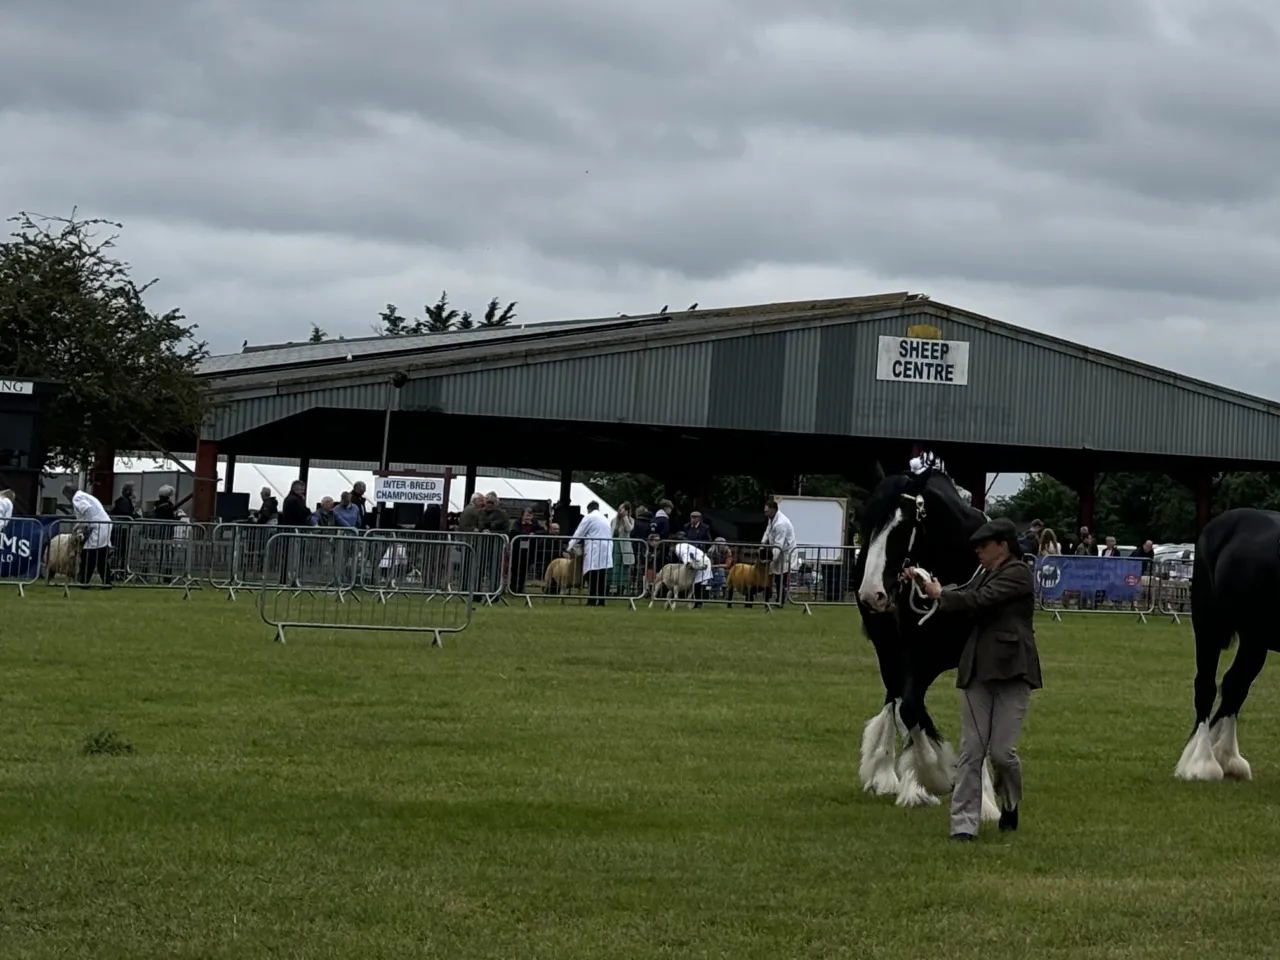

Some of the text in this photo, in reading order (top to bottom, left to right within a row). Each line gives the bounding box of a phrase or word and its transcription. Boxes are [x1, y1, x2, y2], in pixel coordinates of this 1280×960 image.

[899, 340, 949, 360] SHEEP
[892, 360, 954, 382] CENTRE
[376, 490, 442, 501] CHAMPIONSHIPS
